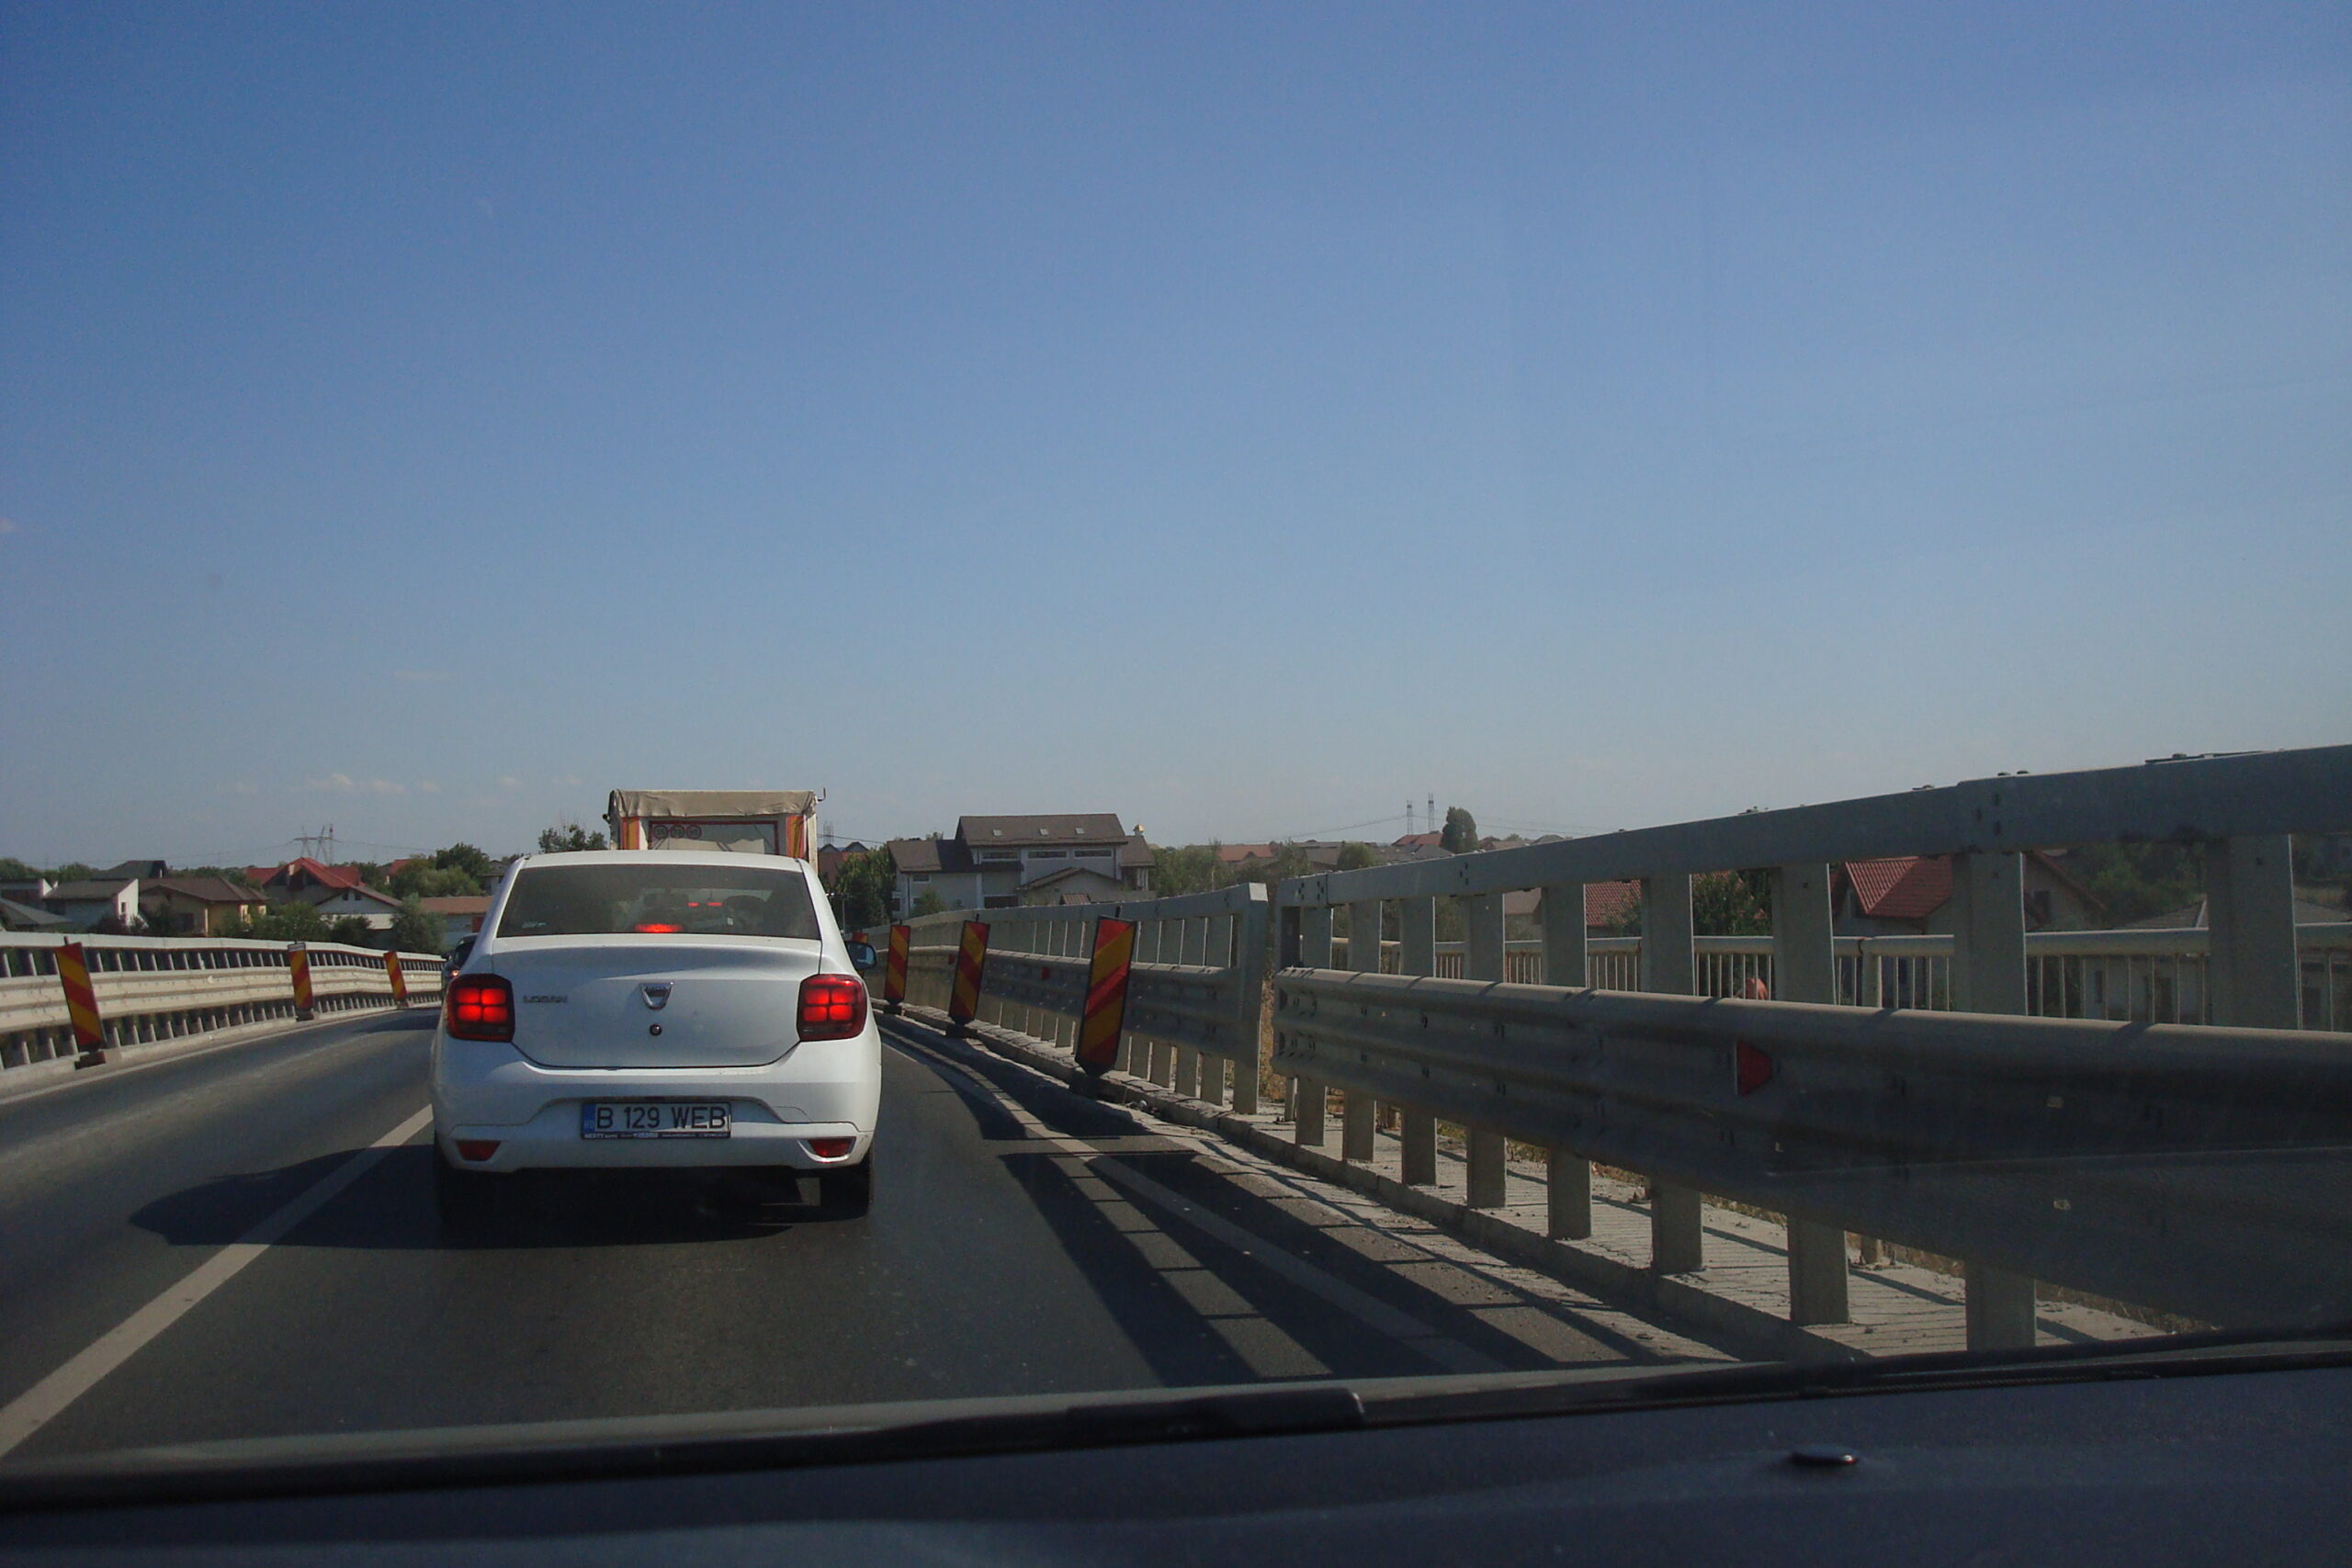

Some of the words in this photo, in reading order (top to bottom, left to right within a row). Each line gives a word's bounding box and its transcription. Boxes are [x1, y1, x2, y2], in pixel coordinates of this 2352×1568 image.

[597, 1107, 613, 1129] B
[625, 1106, 660, 1128] 129
[671, 1106, 726, 1129] WEB
